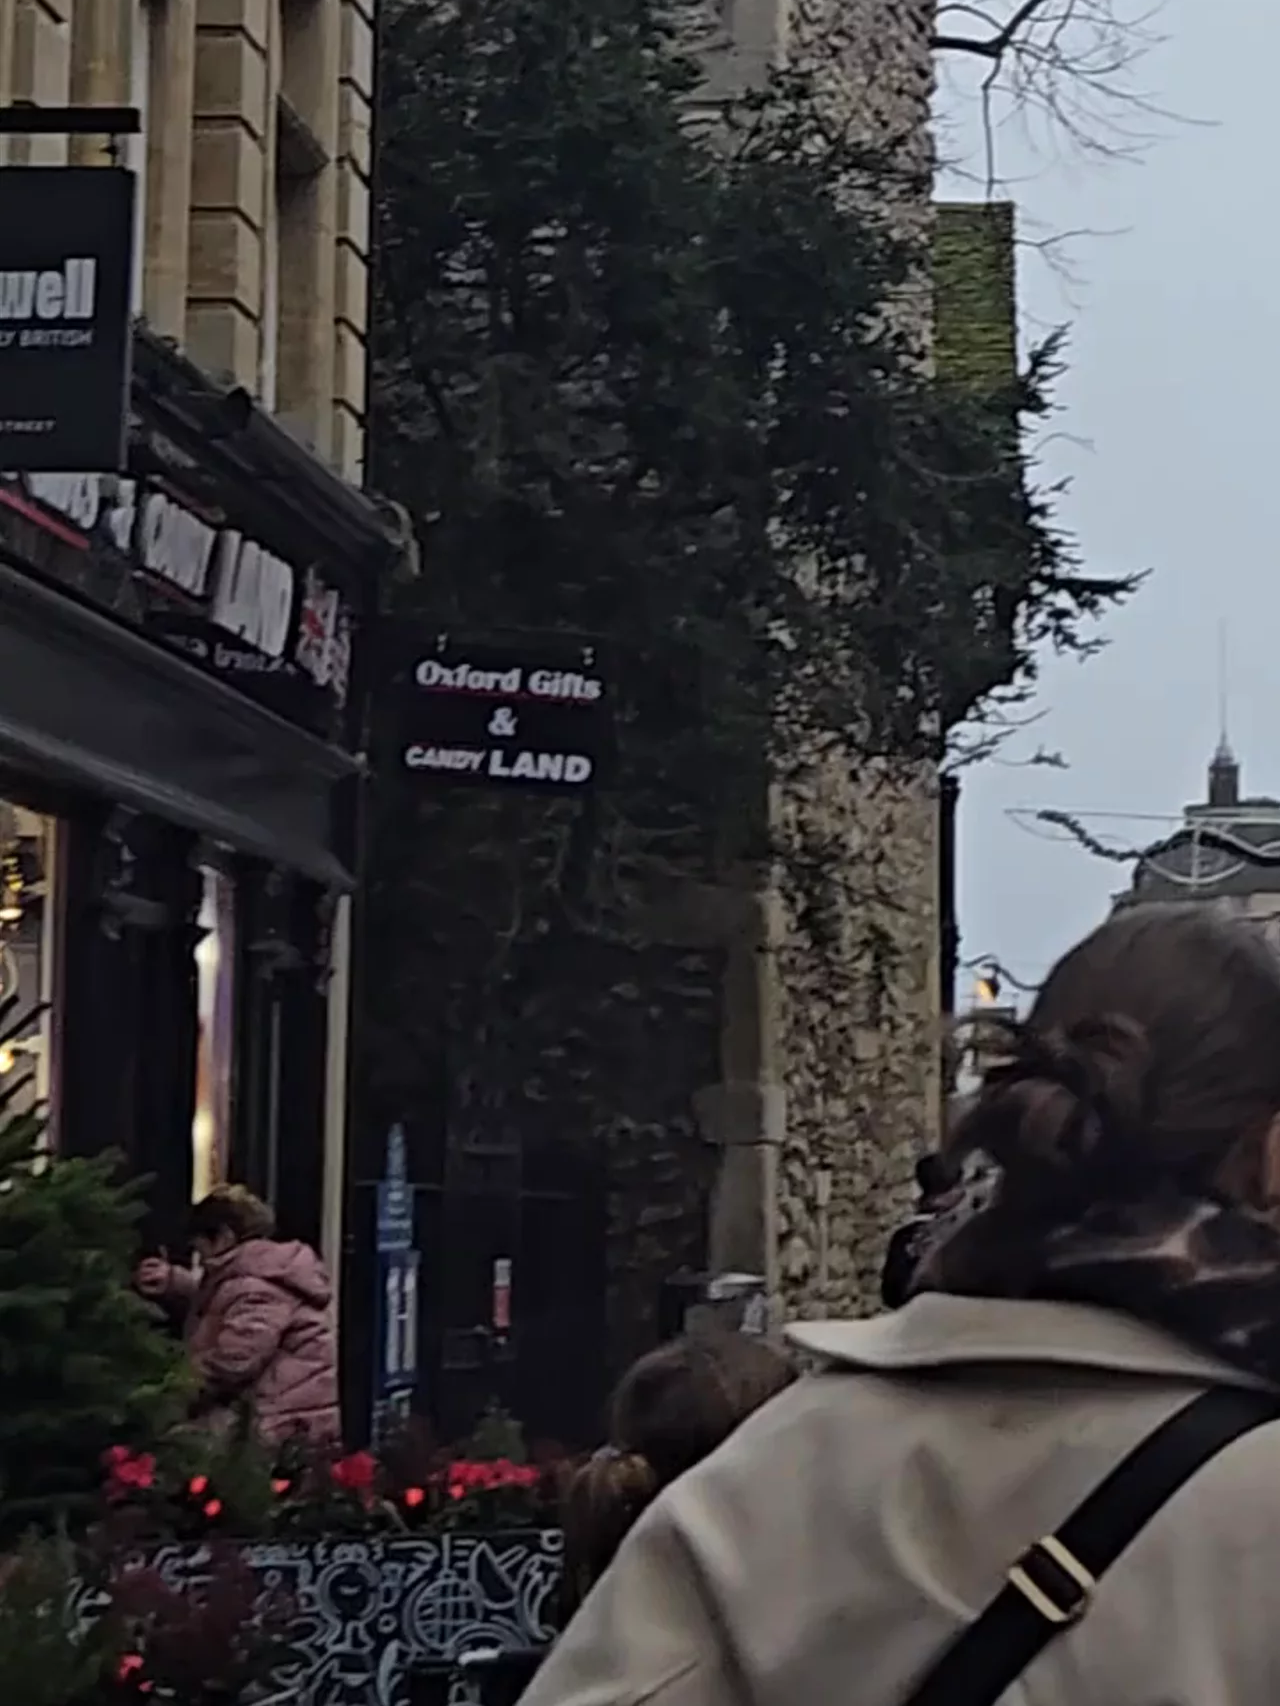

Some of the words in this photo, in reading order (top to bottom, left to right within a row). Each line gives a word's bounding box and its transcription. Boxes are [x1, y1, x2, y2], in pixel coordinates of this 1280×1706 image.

[416, 660, 522, 692] Oxford
[528, 670, 602, 699] Gifts
[488, 707, 518, 736] &
[405, 746, 486, 771] CANDY
[488, 750, 592, 782] LAND
